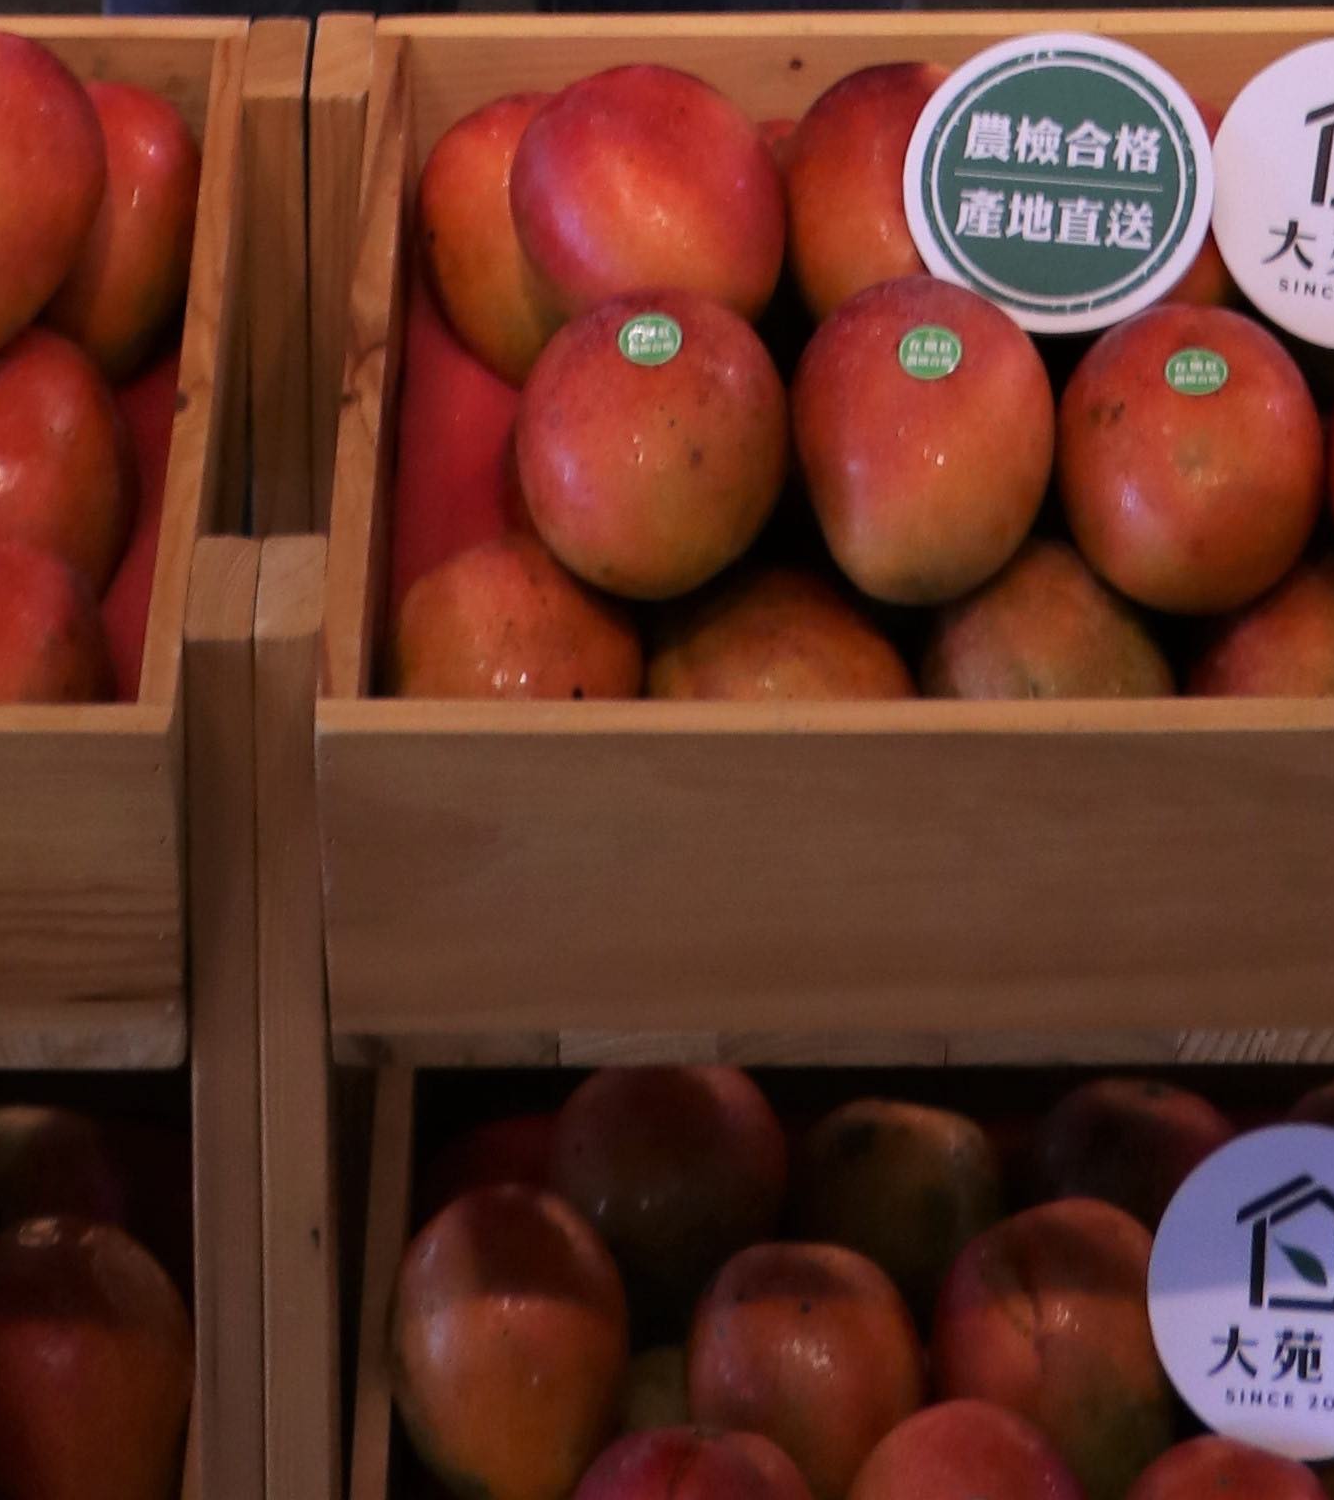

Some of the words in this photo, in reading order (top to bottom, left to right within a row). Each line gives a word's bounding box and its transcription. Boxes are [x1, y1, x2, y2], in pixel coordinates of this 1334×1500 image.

[963, 110, 1163, 175] 農檢合格
[954, 189, 1154, 251] 產地直送
[1225, 1388, 1294, 1407] SINCE
